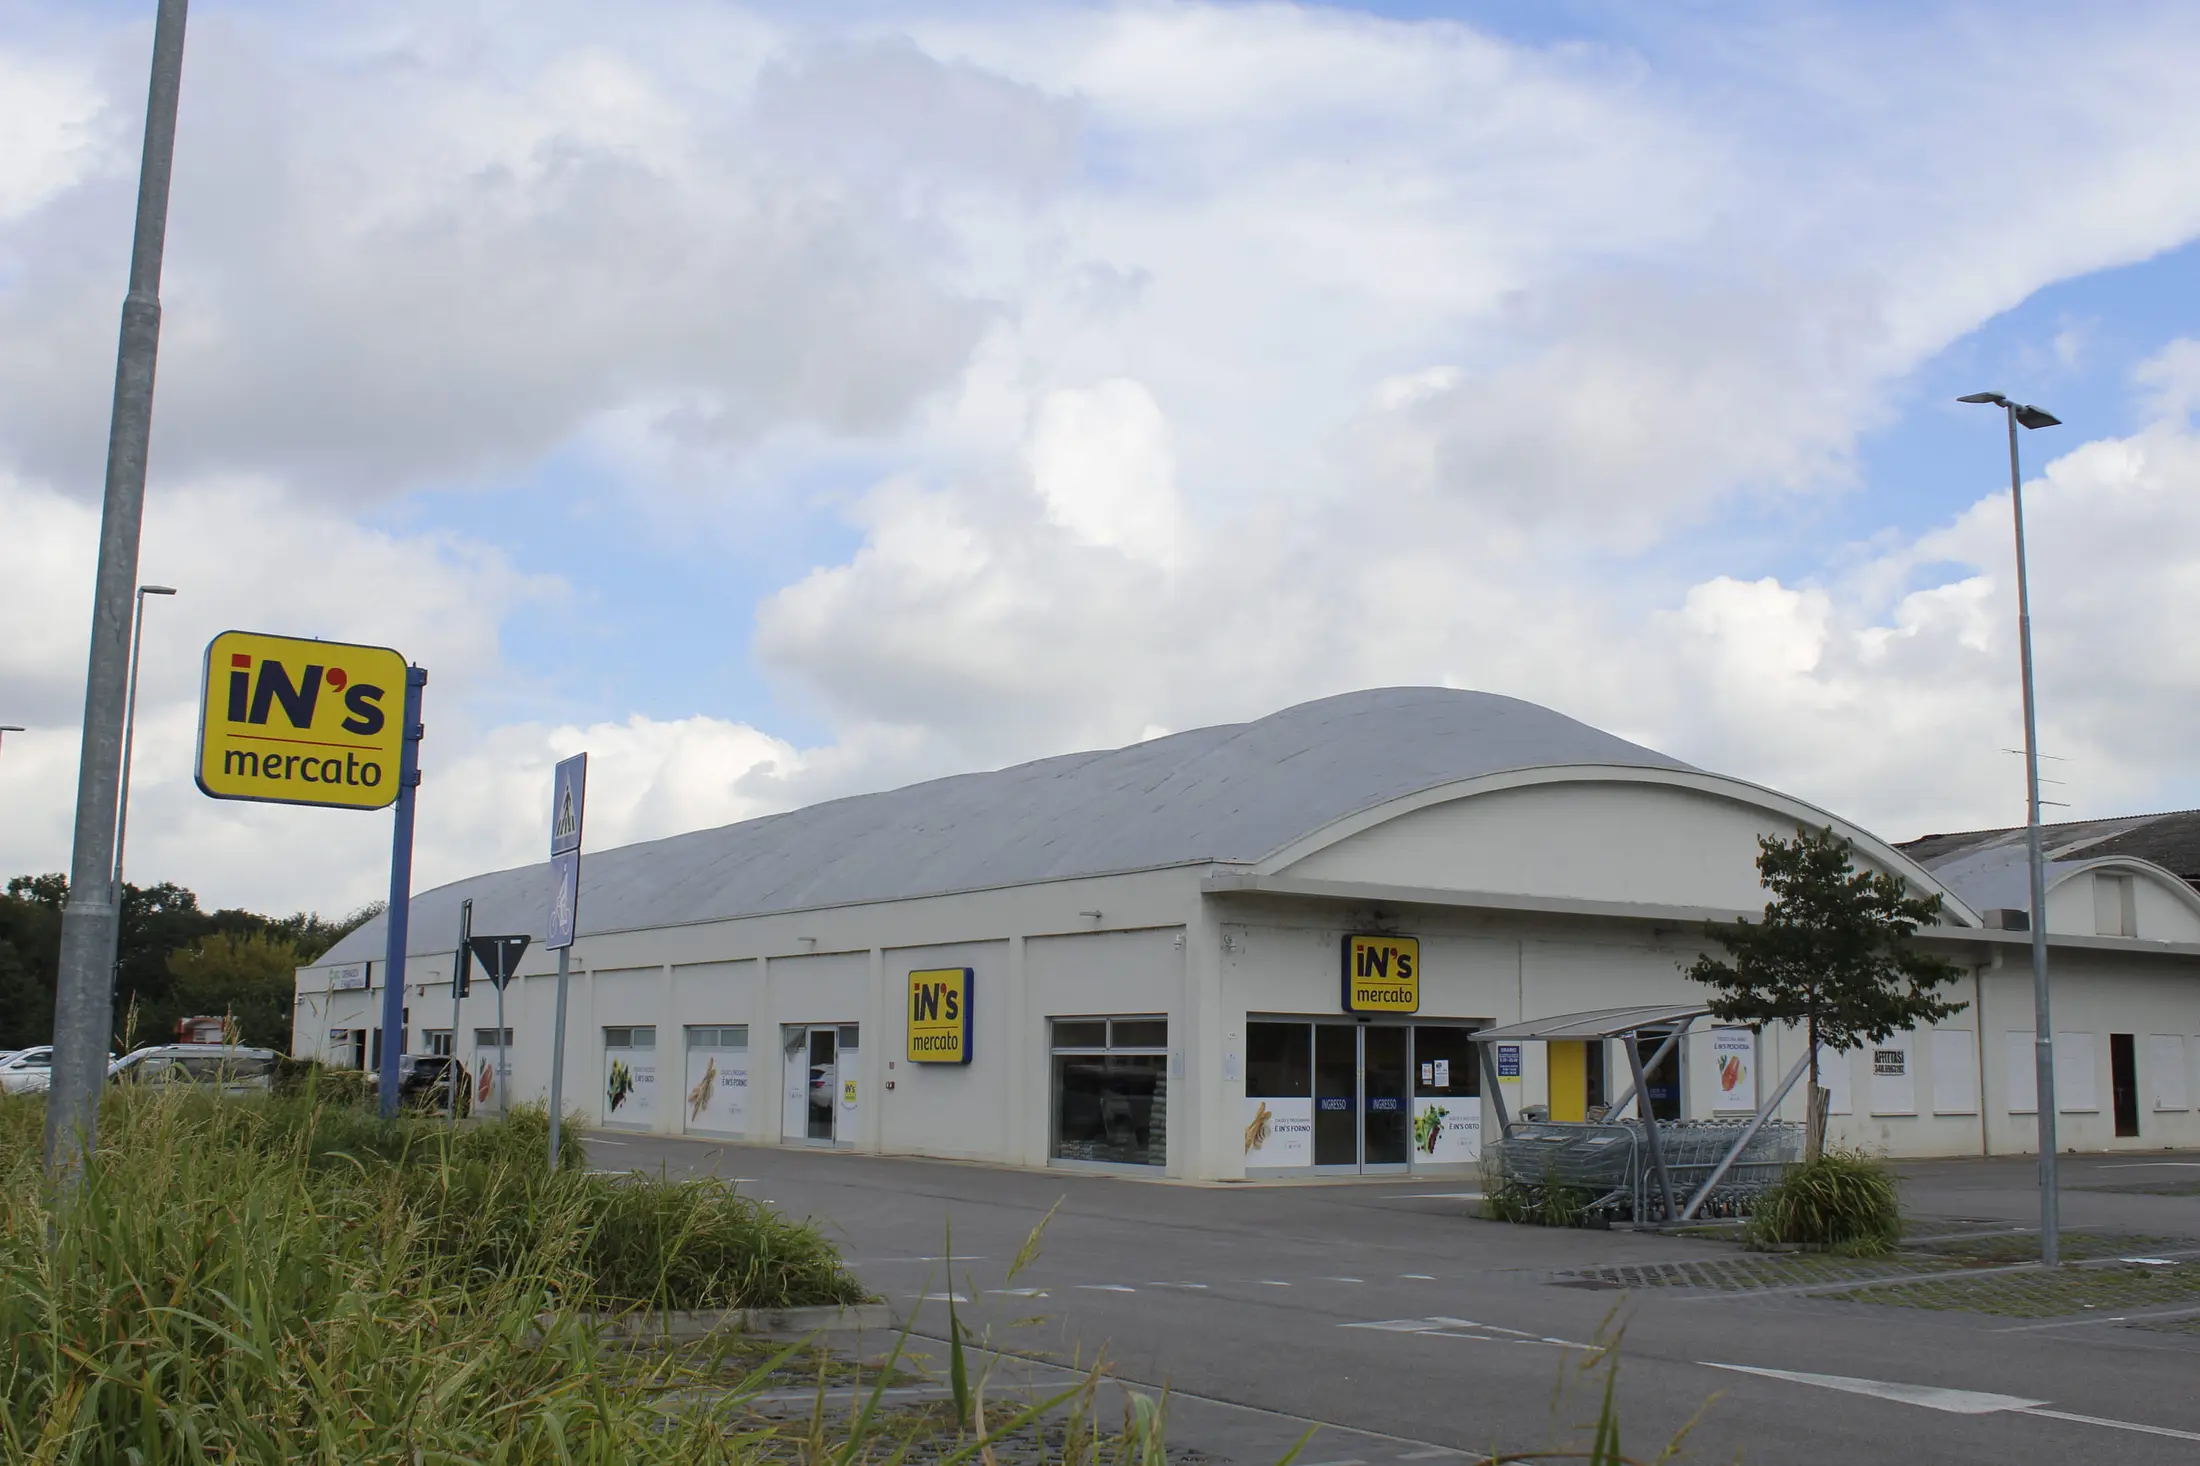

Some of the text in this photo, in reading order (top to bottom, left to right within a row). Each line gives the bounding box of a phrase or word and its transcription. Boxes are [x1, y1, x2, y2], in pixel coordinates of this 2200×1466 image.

[228, 654, 385, 736] iN's
[224, 749, 381, 787] mercato
[1356, 944, 1412, 979] iN's
[914, 983, 959, 1021] iN's
[1357, 987, 1412, 1003] mercato
[913, 1031, 958, 1051] mercato
[1875, 1051, 1904, 1063] AFFITTASI
[1321, 1099, 1347, 1110] INGRESSO
[1372, 1099, 1397, 1110] INGRESSO
